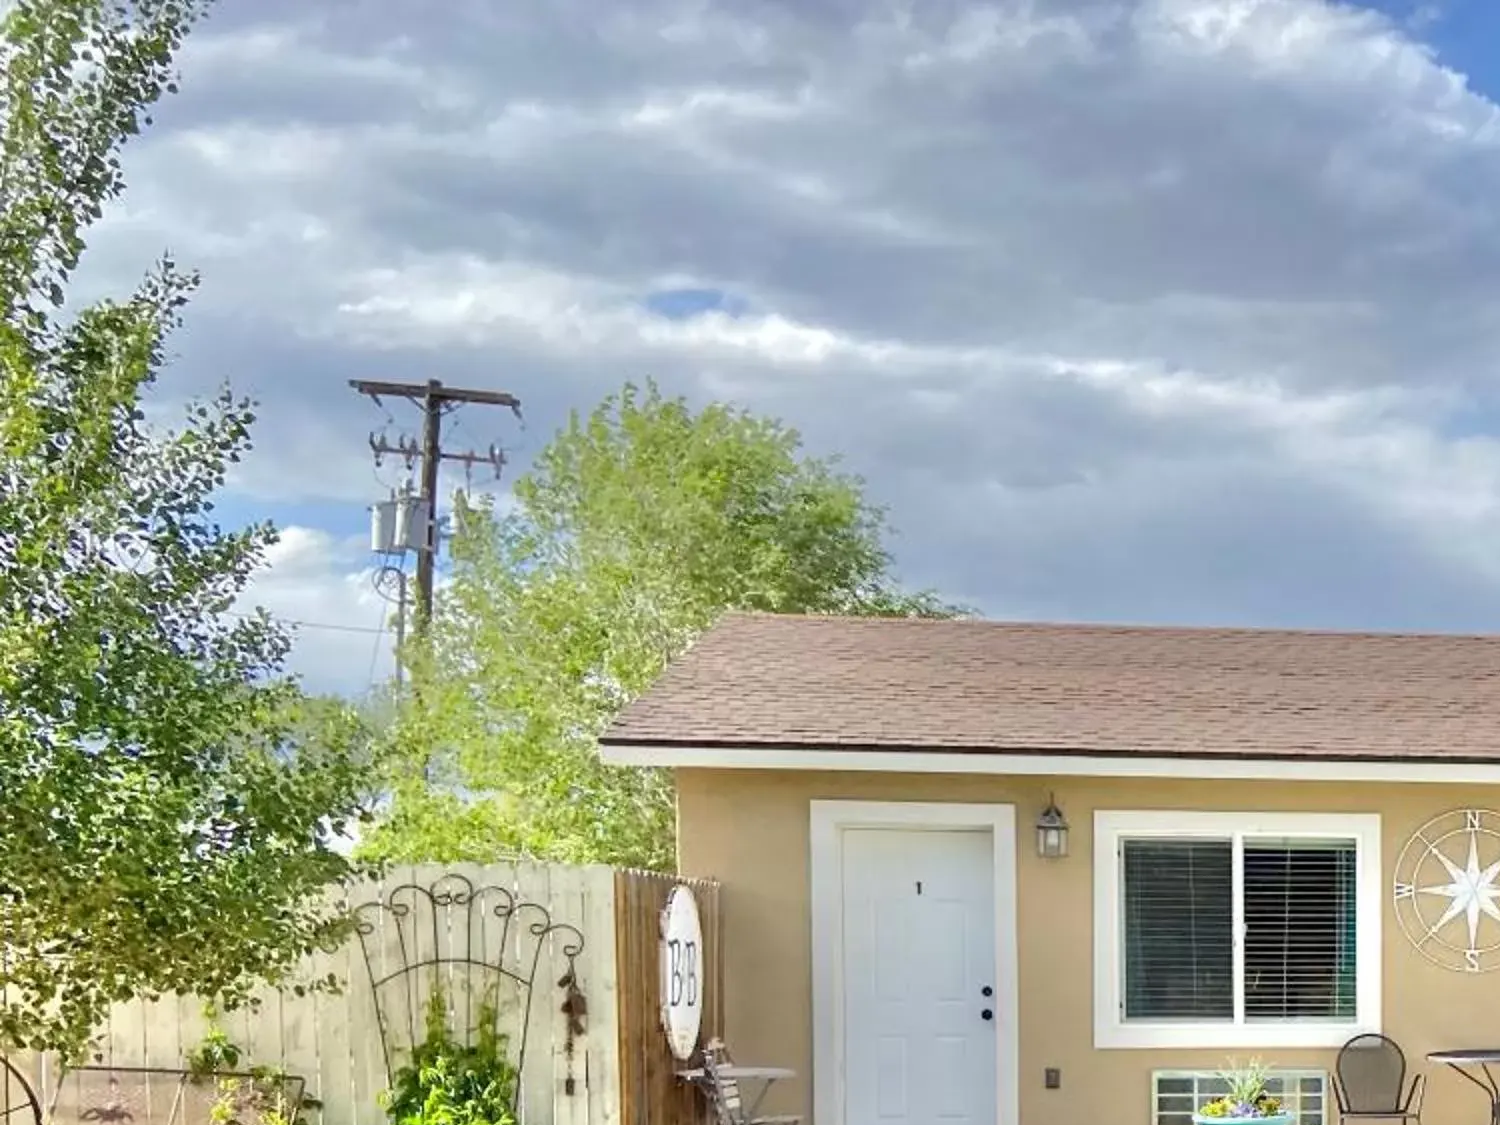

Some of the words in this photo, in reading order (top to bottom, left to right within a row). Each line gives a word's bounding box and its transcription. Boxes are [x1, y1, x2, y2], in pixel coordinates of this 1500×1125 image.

[1467, 809, 1480, 830] N
[916, 881, 922, 896] 1
[1464, 950, 1480, 972] S
